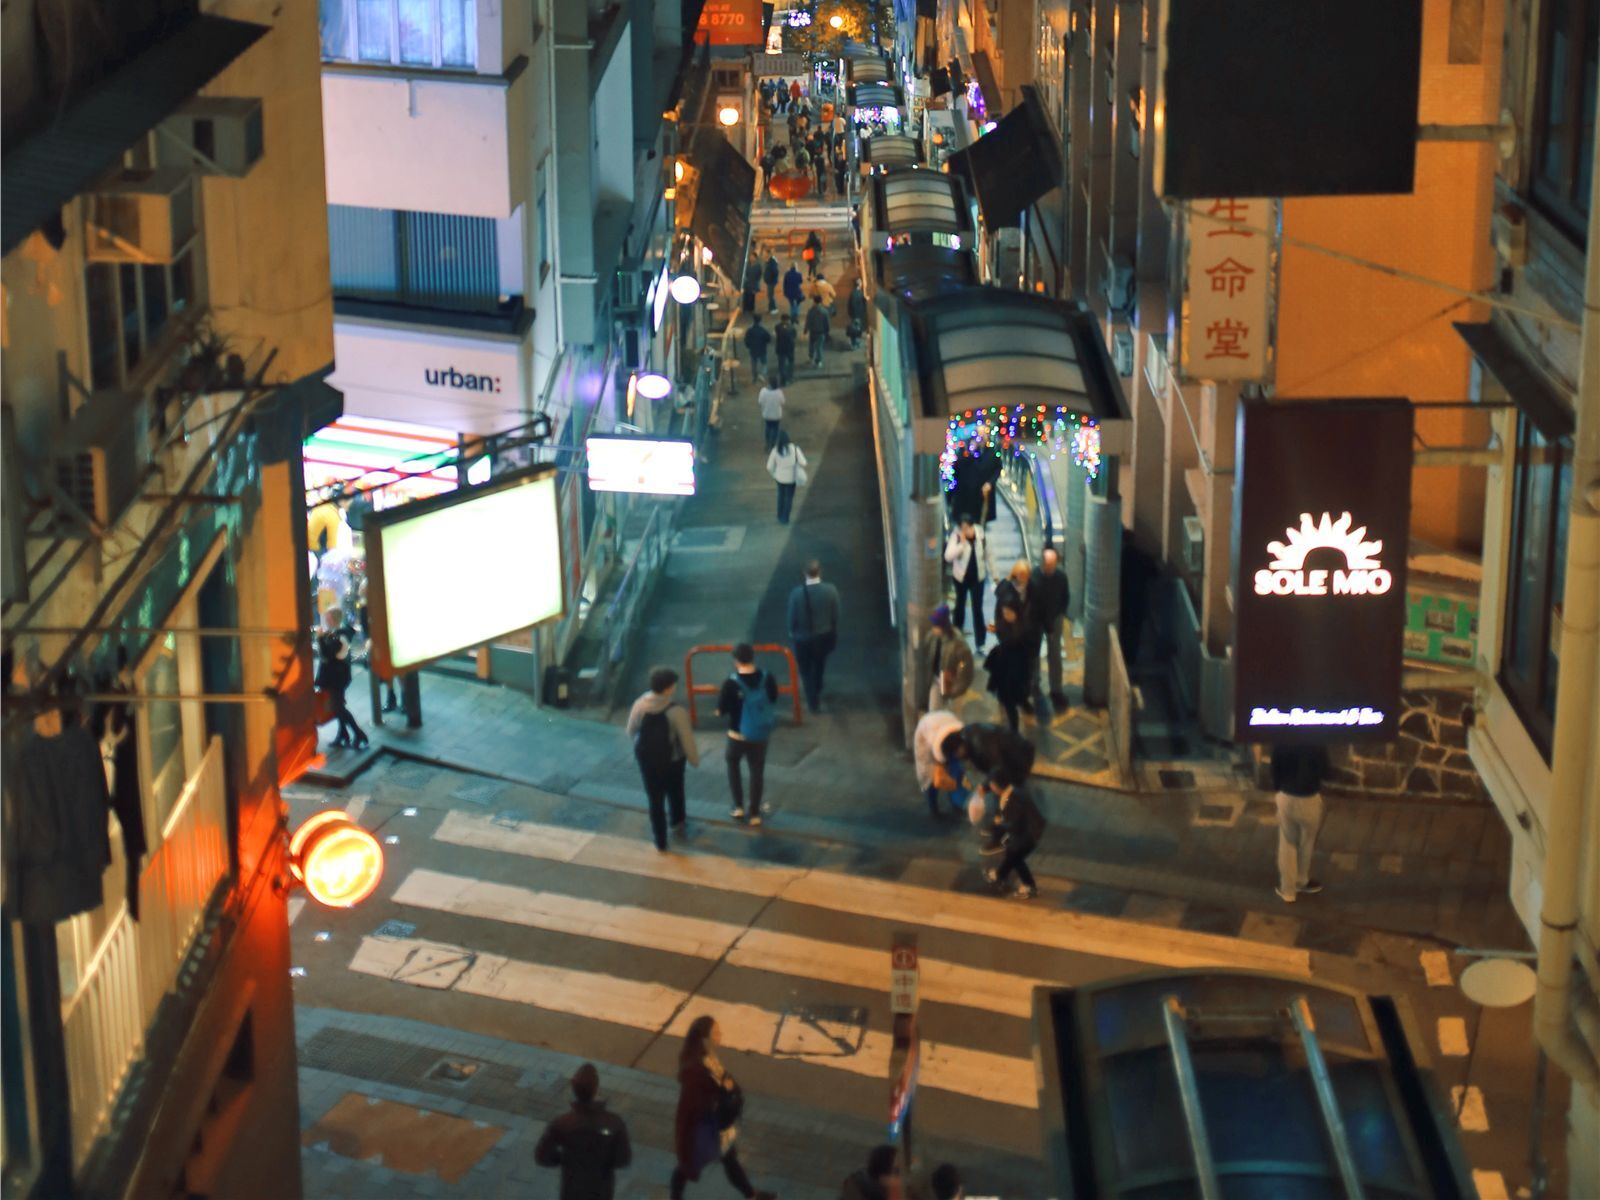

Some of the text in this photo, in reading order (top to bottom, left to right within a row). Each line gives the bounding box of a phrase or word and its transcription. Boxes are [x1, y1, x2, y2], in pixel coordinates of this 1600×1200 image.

[711, 13, 744, 26] 8770
[1205, 197, 1255, 360] 生命堂
[1254, 569, 1392, 595] SOLE MIO
